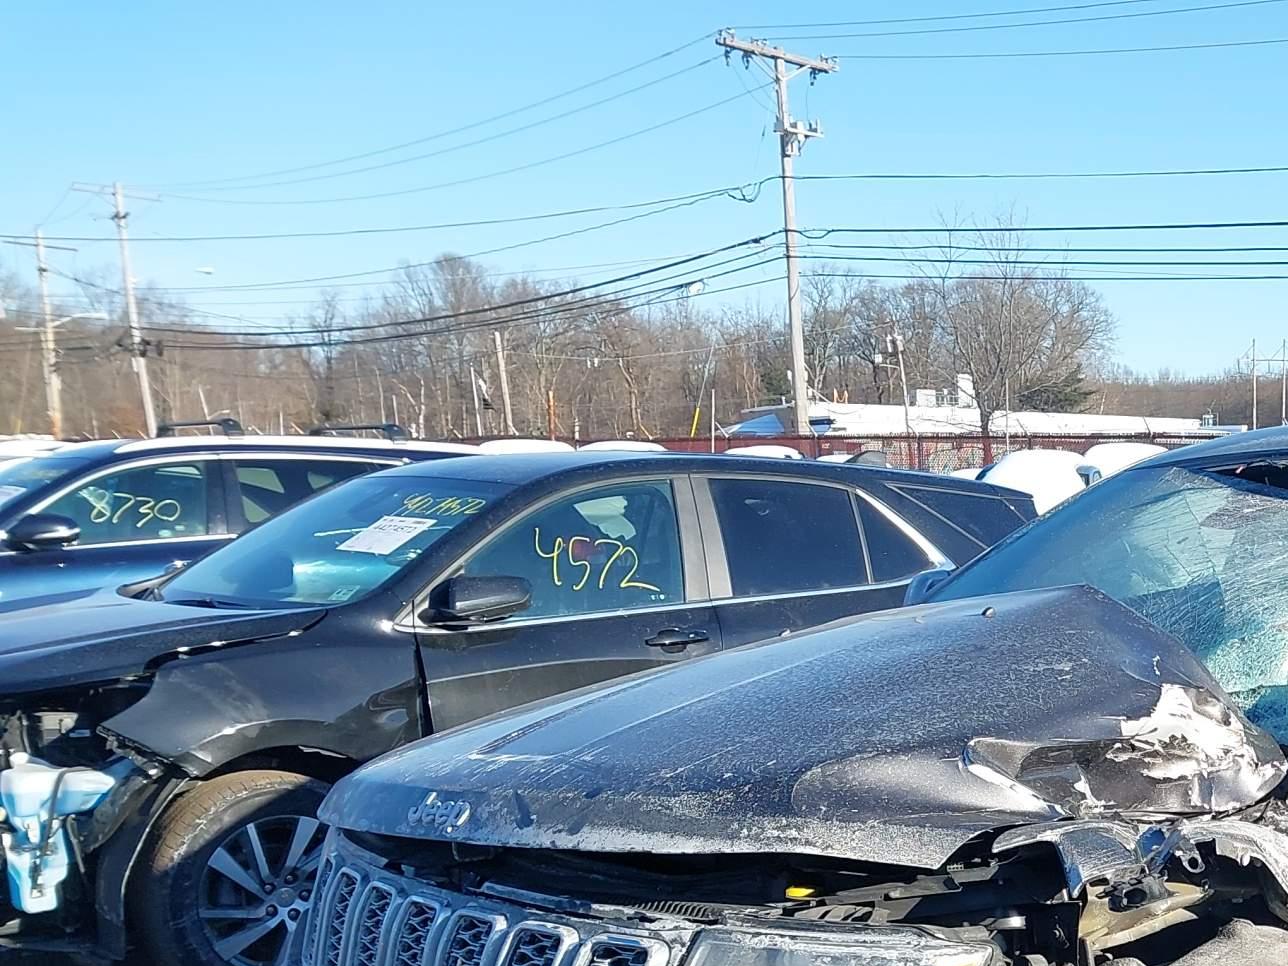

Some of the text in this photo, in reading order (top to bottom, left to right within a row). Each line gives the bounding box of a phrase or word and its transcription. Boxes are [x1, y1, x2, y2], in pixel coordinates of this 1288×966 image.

[79, 486, 181, 528] 8730
[534, 527, 661, 592] 4572
[407, 791, 472, 834] Jeep
